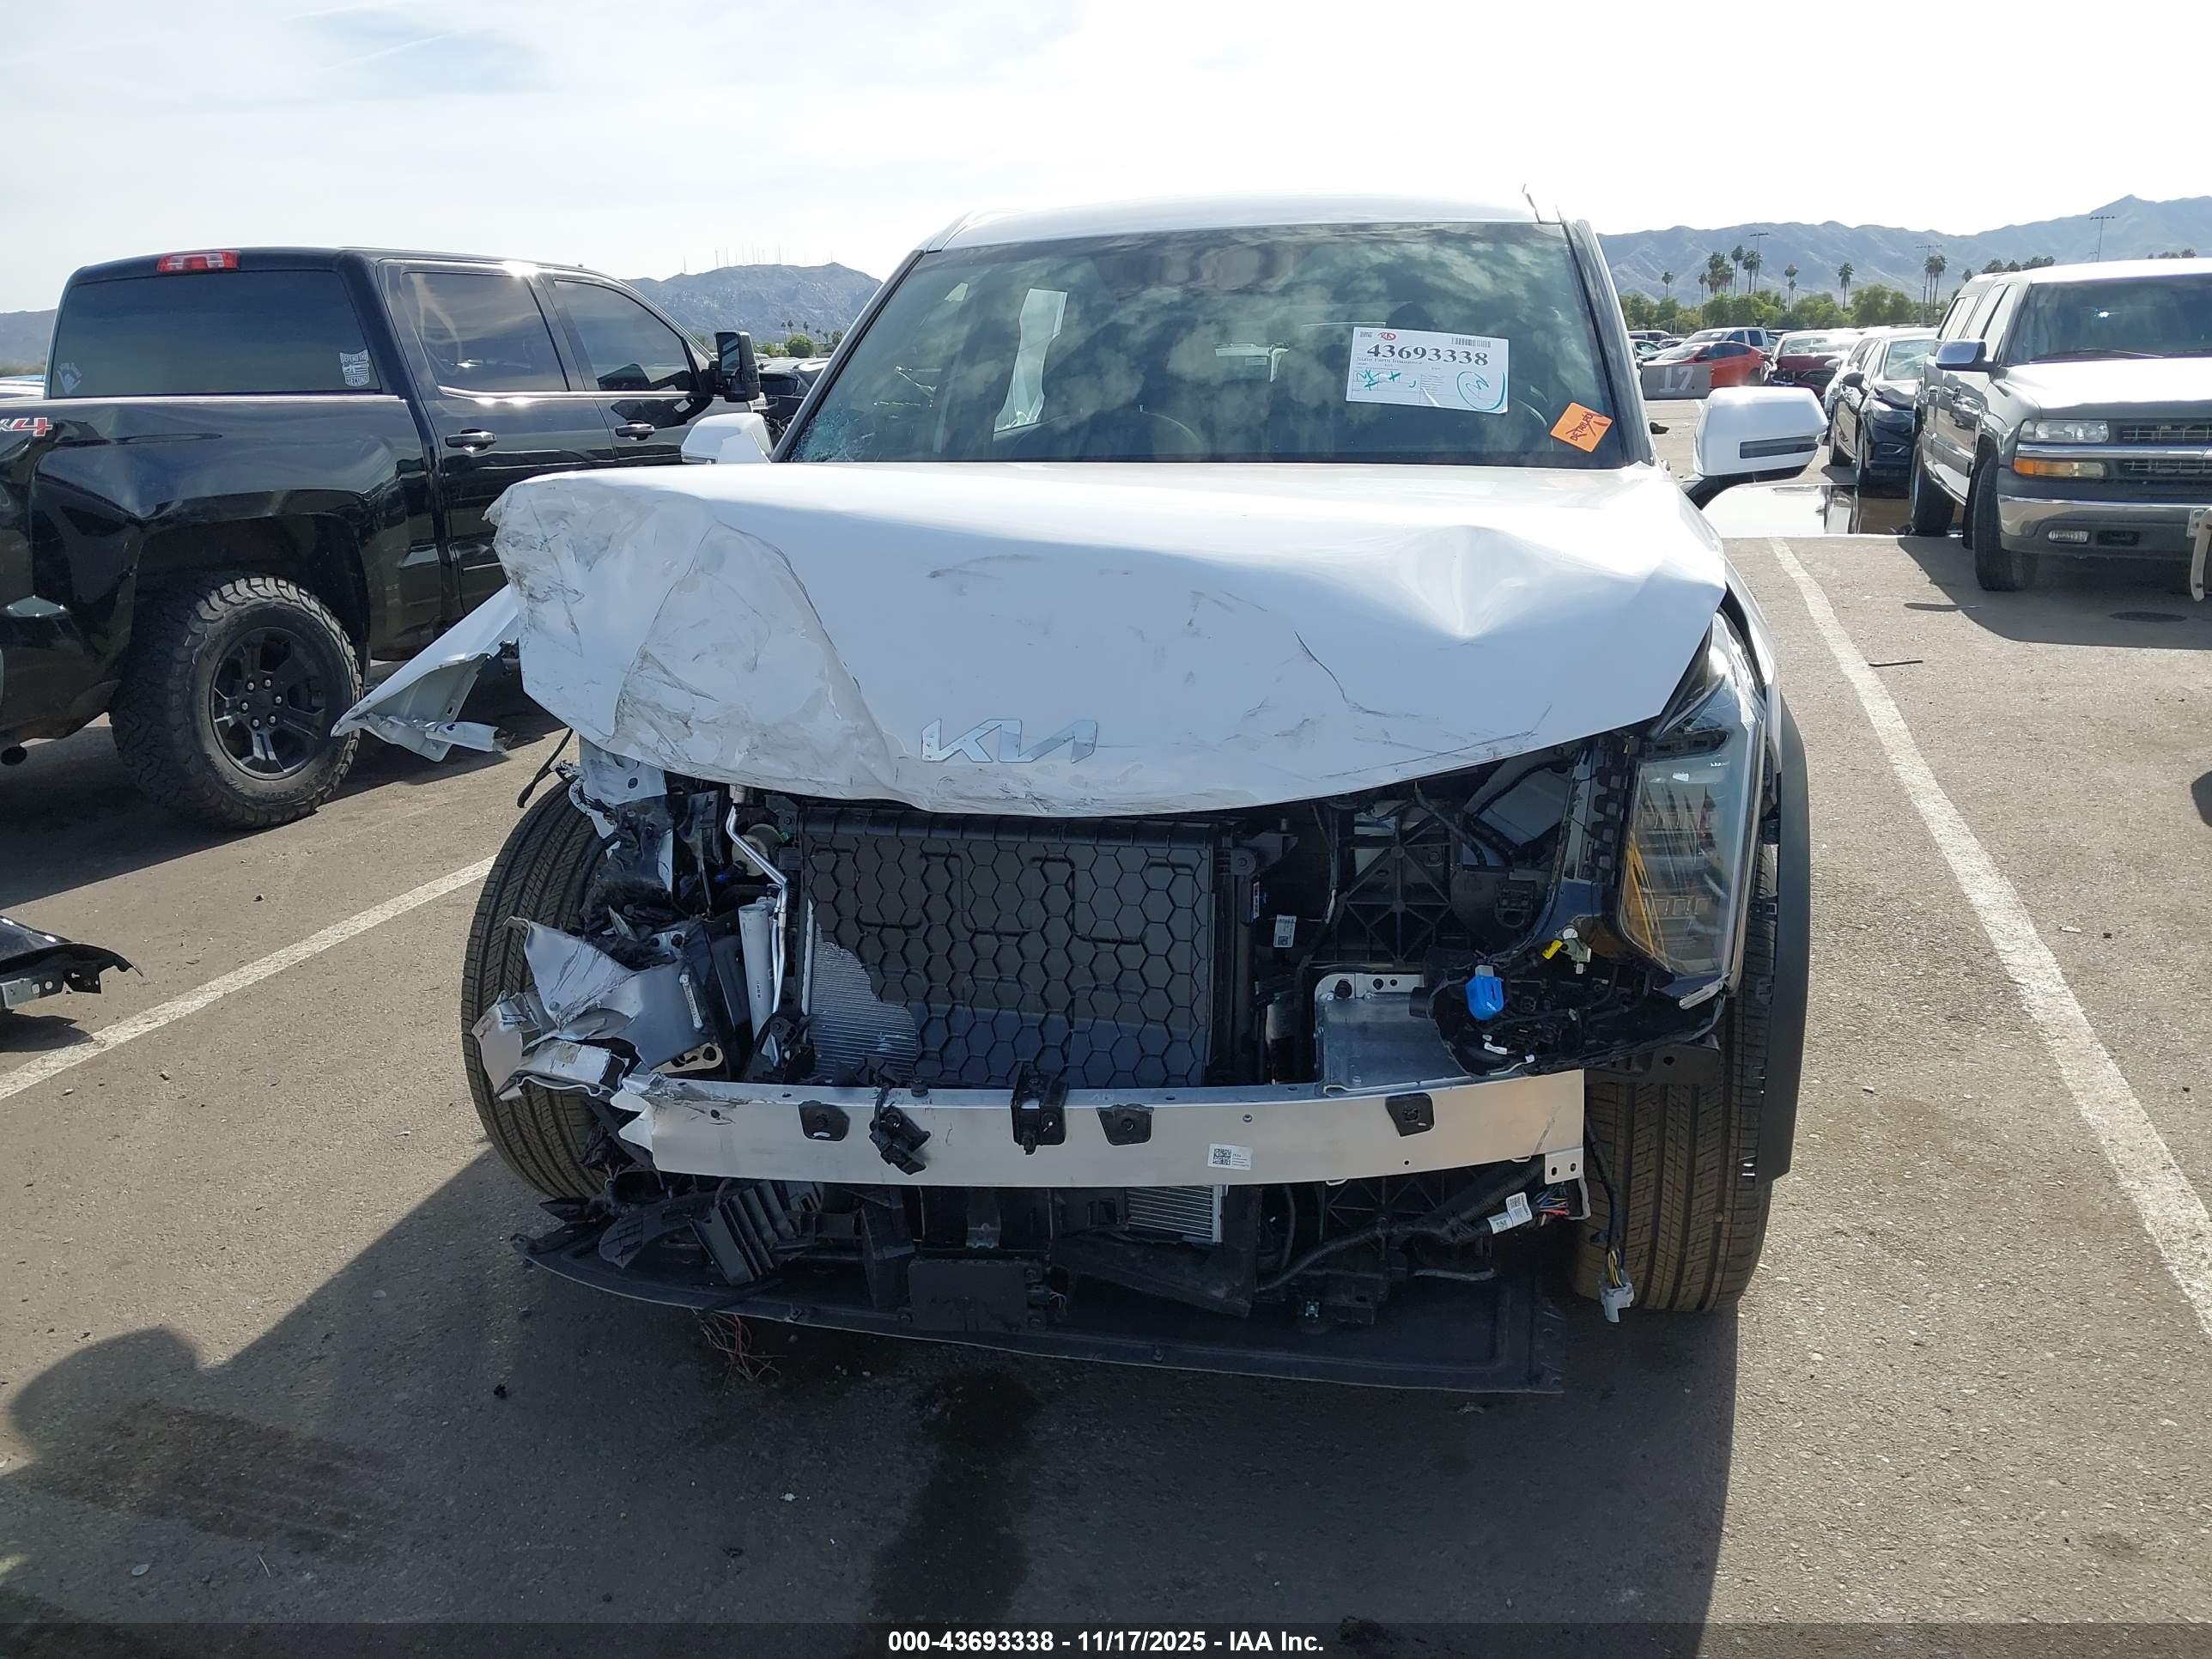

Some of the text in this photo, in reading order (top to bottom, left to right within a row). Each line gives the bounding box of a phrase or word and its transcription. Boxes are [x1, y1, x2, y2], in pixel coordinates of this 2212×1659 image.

[1367, 344, 1488, 366] 43693338
[1658, 367, 1694, 393] 17
[921, 719, 1097, 763] KIA
